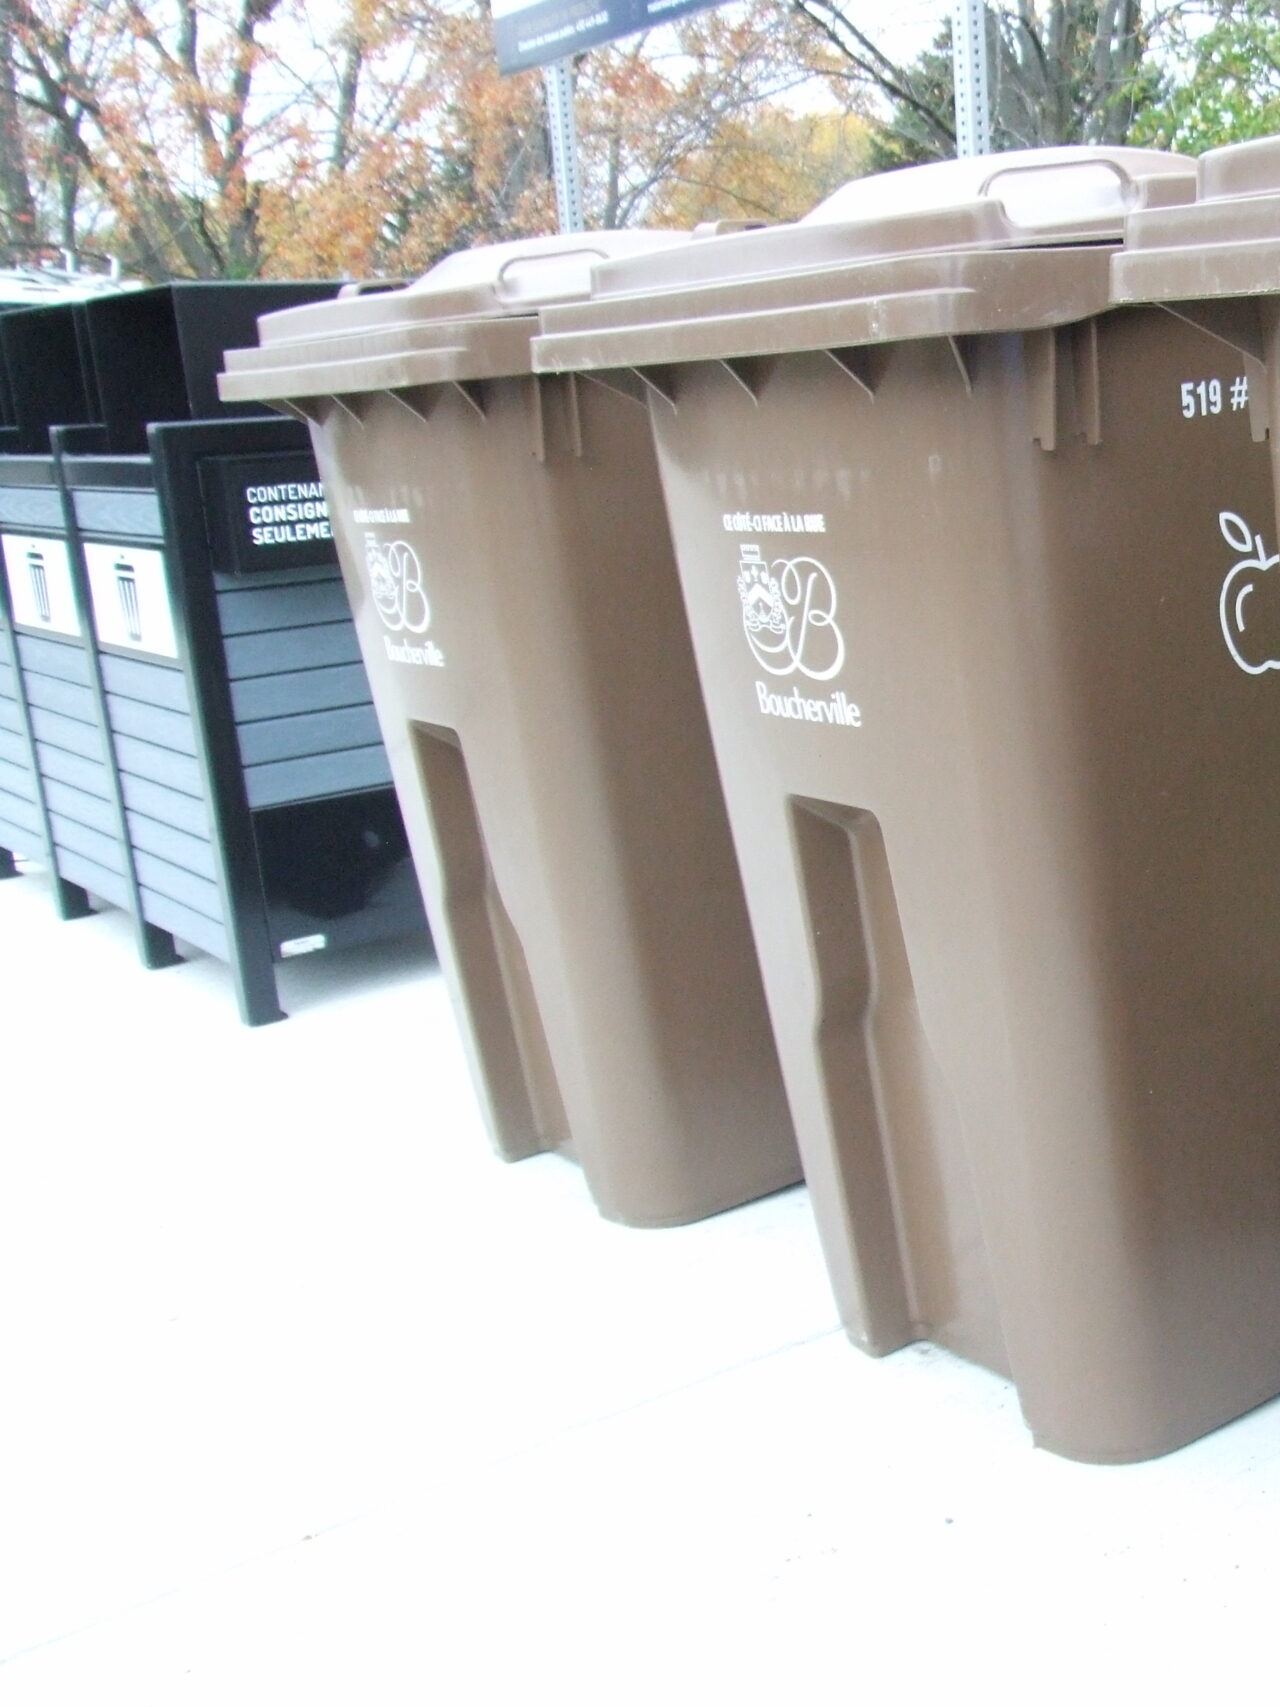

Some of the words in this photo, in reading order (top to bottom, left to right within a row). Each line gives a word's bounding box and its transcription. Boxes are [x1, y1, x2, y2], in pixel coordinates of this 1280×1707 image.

[1181, 378, 1222, 418] 519
[1230, 376, 1249, 412] #
[252, 521, 334, 546] SEULEME
[761, 514, 785, 532] FACE
[791, 515, 805, 532] LA
[755, 680, 862, 728] Boucherville
